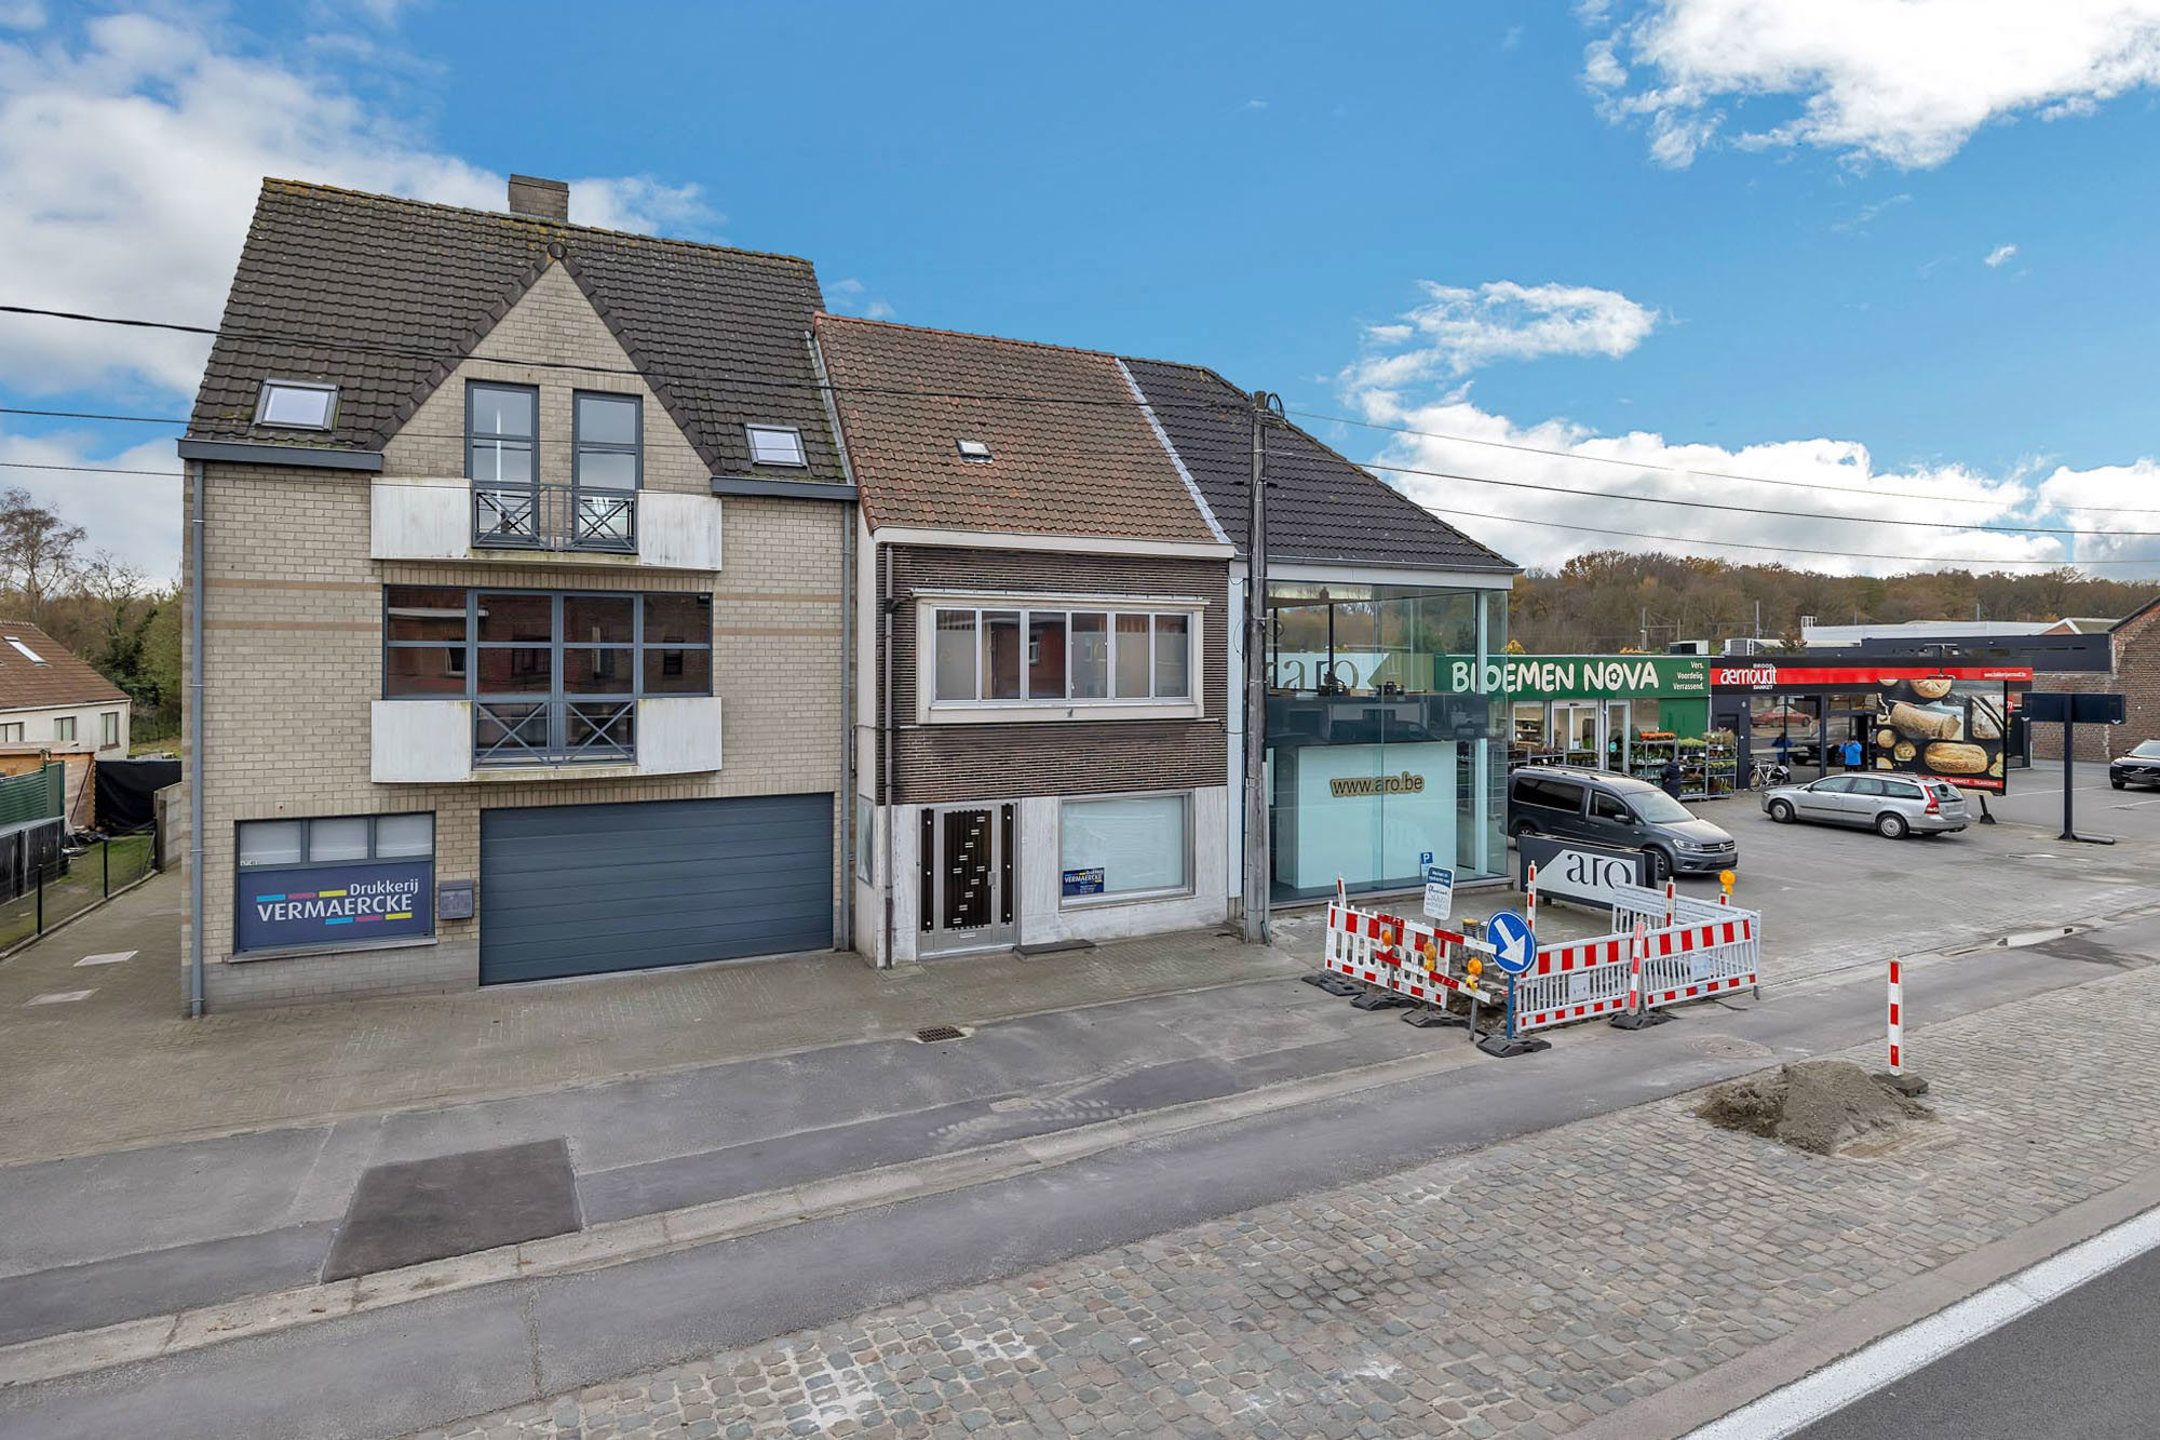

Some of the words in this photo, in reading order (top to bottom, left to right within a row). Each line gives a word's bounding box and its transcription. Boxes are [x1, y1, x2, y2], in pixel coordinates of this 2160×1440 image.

[1690, 661, 1704, 669] Vers.
[1452, 661, 1575, 692] BLOEMEN
[1583, 661, 1659, 691] NOVA
[1676, 671, 1704, 681] Voordelig.
[1672, 682, 1704, 690] Verrassend.
[1333, 774, 1423, 795] www.aro.be
[1566, 853, 1632, 889] aro
[350, 878, 419, 896] Drukkerij
[256, 893, 412, 922] VERMAERCKE
